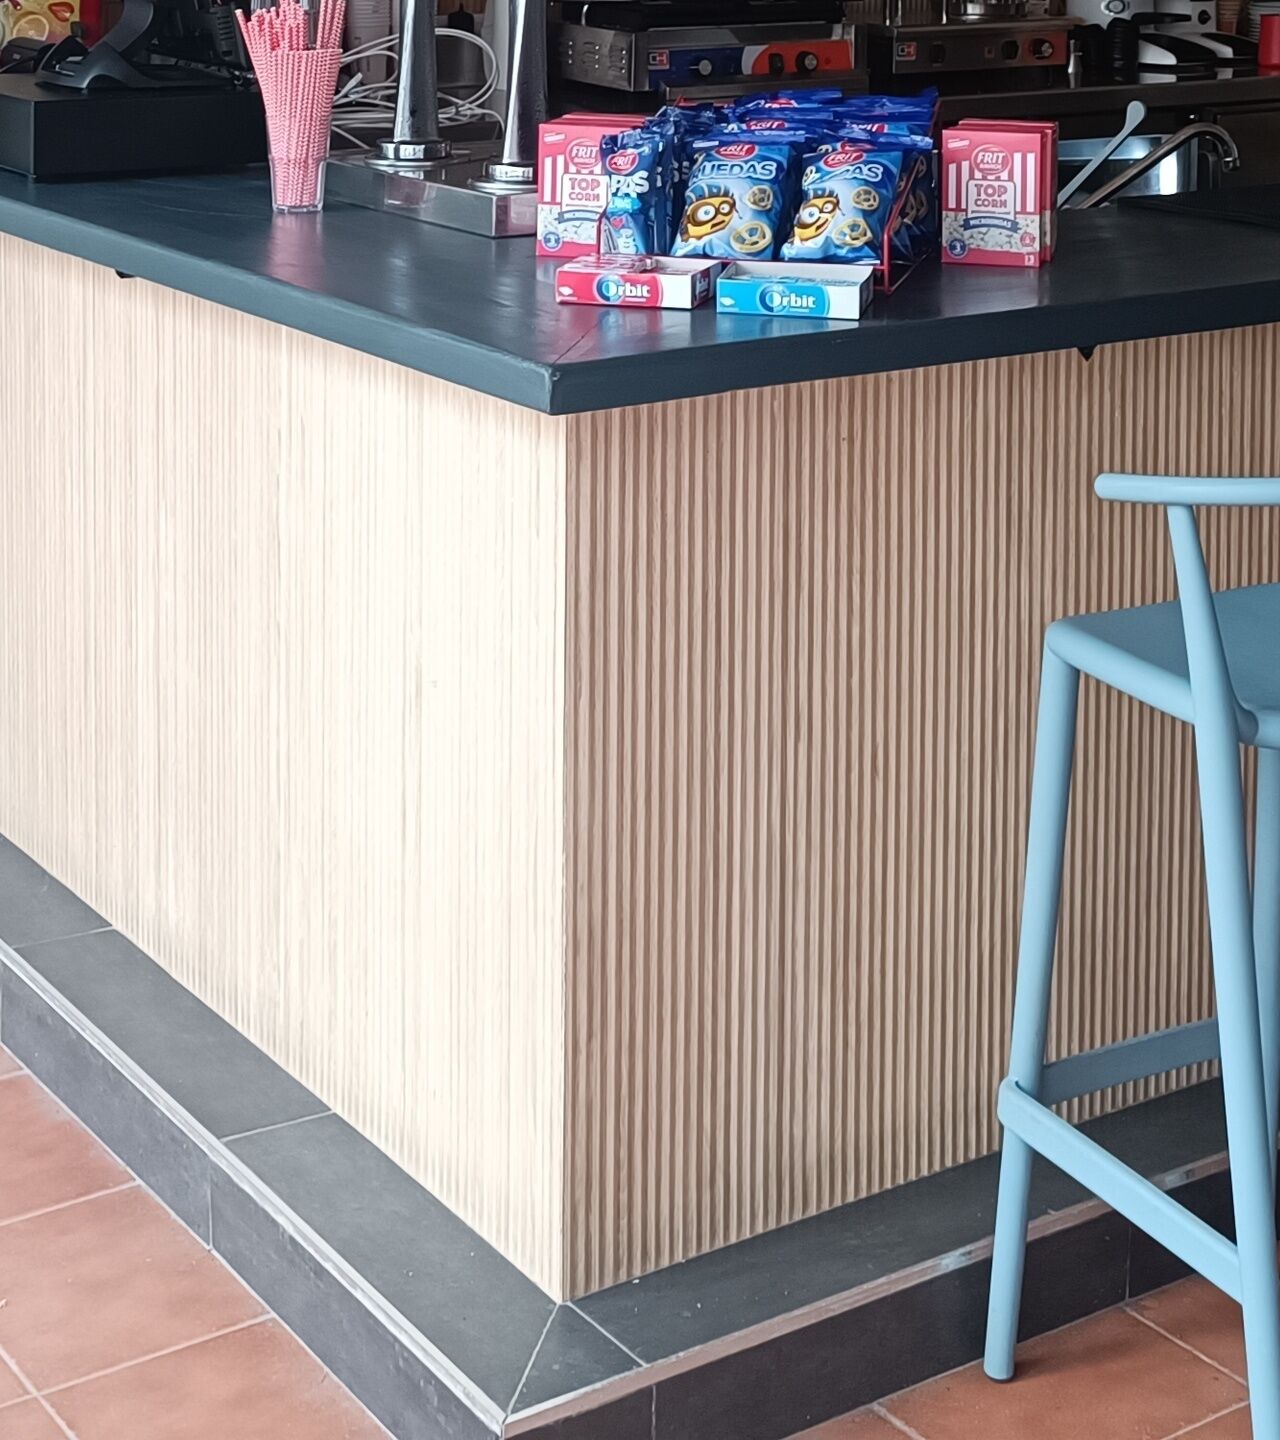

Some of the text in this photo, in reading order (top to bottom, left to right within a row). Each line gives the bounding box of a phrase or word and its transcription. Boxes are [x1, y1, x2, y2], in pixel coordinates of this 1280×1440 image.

[571, 145, 599, 158] FRIT
[719, 144, 751, 153] FRIT
[827, 151, 861, 163] FRIT
[977, 152, 1006, 164] FRIT
[569, 177, 600, 192] TOP
[568, 191, 600, 202] CORN
[974, 184, 1008, 198] TOP
[974, 198, 1007, 209] CORN
[602, 279, 651, 298] Orbit
[766, 291, 816, 308] Orbit
